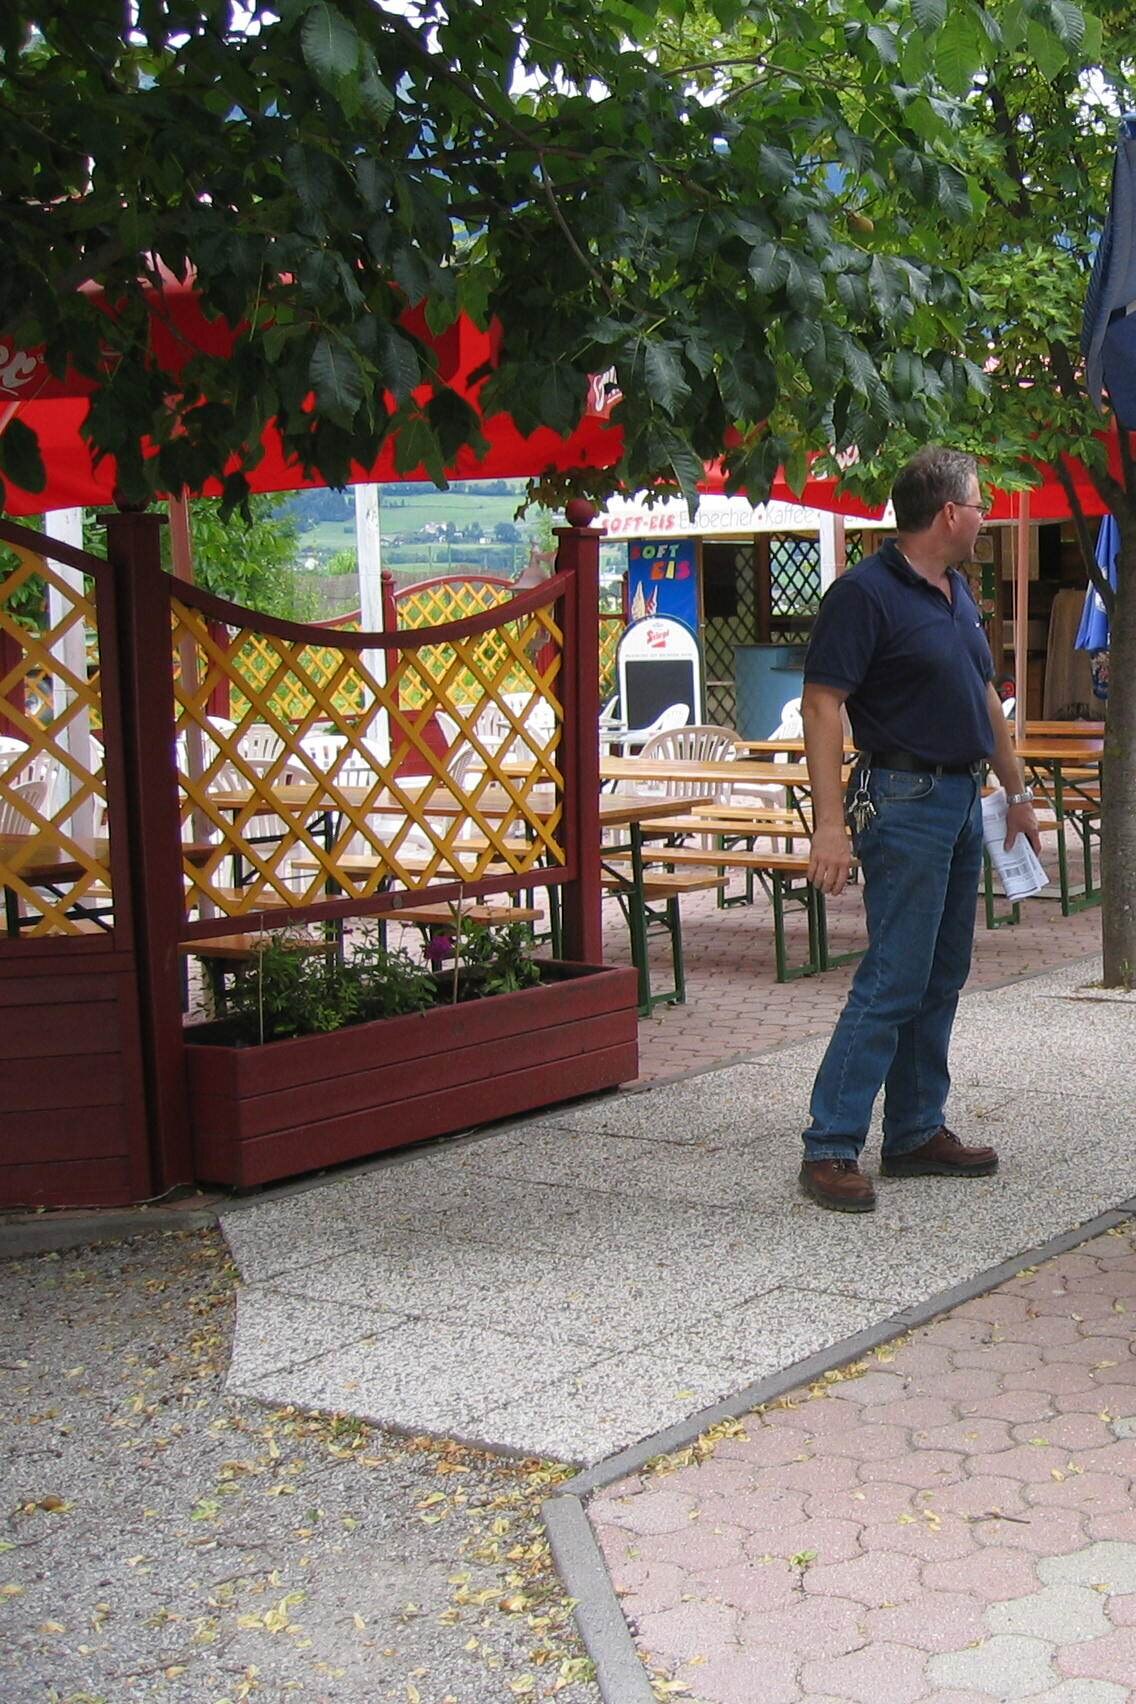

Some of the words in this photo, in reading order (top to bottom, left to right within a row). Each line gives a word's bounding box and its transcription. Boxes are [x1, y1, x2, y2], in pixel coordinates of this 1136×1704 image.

[601, 514, 675, 532] SOFT-EIS
[679, 507, 753, 530] Ebecher
[630, 544, 679, 560] SOFT
[651, 560, 691, 580] EIS
